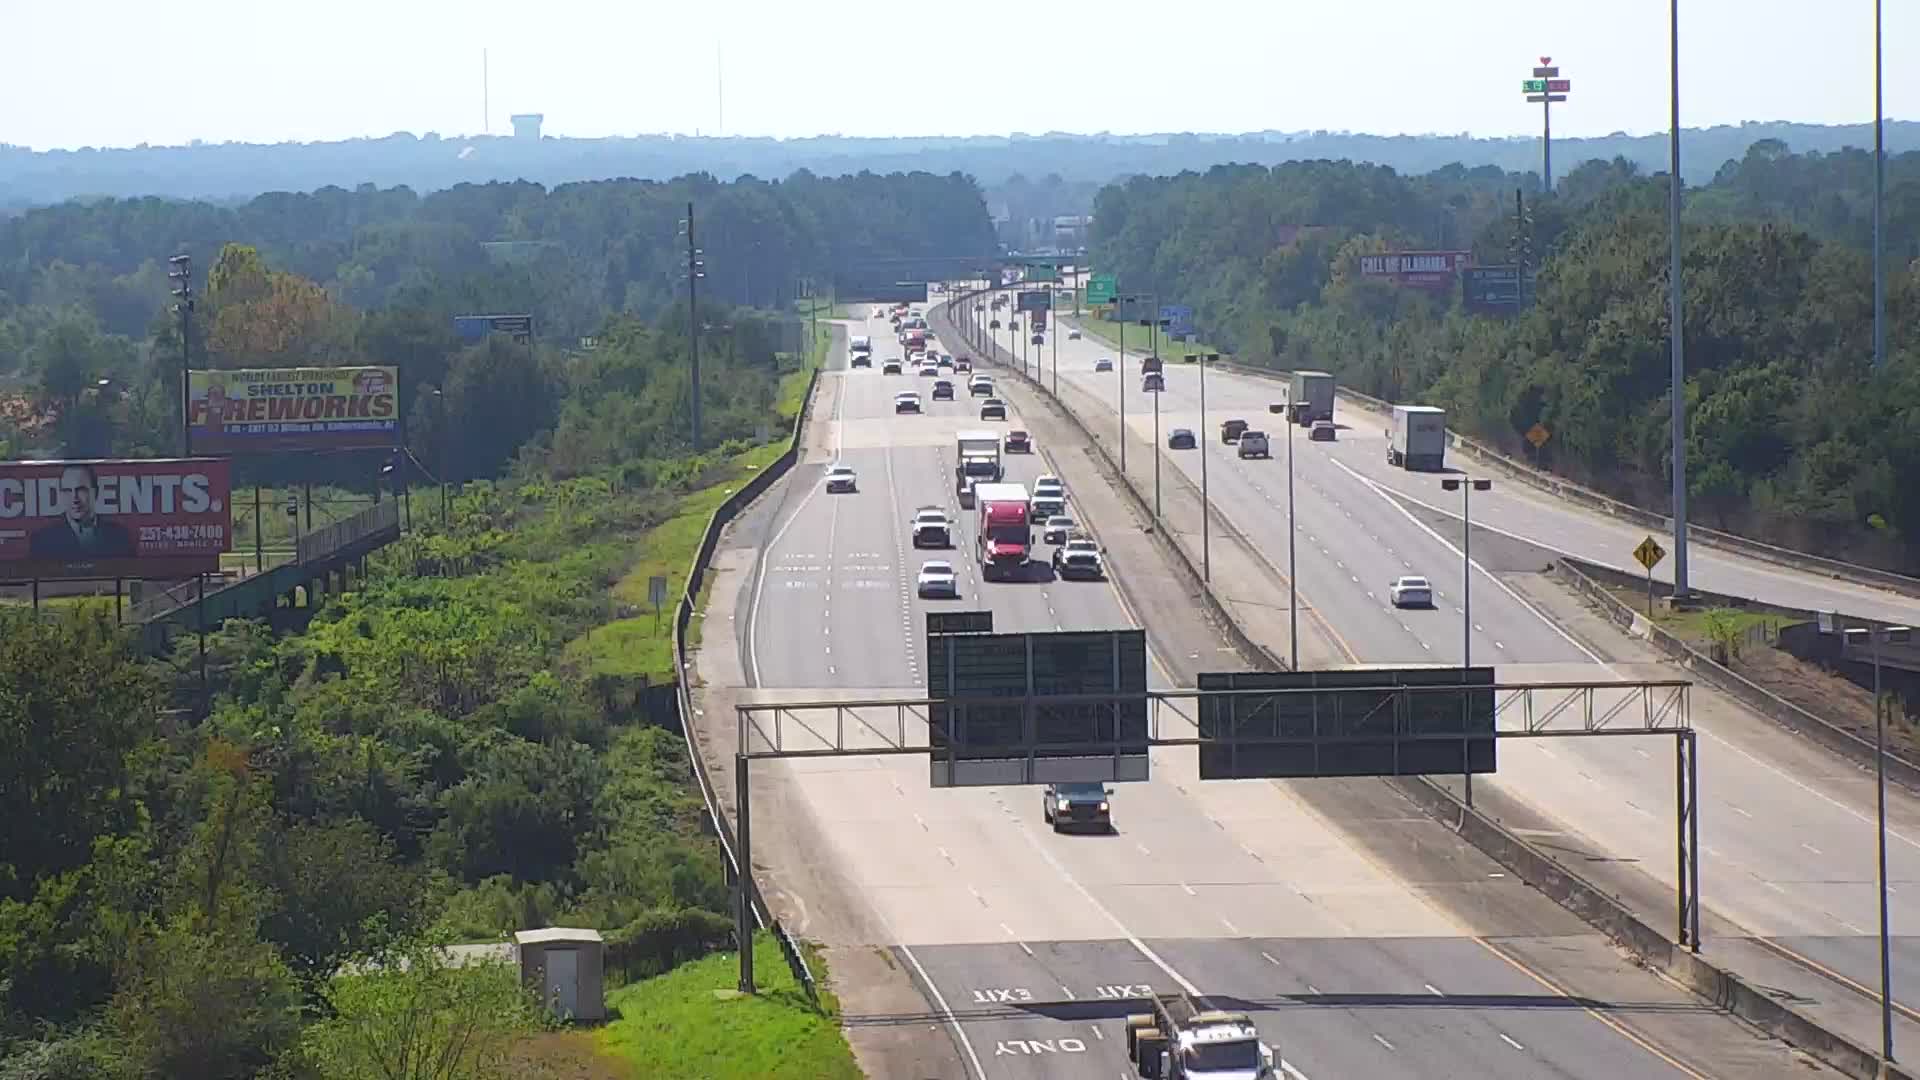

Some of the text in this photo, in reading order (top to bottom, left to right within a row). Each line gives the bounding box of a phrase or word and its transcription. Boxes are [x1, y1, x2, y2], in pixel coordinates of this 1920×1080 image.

[248, 382, 334, 397] SHELTON
[191, 393, 394, 423] FREWORKS
[973, 988, 1034, 1003] EXIT
[1095, 984, 1153, 999] EXIT
[994, 1038, 1087, 1057] ONLY
